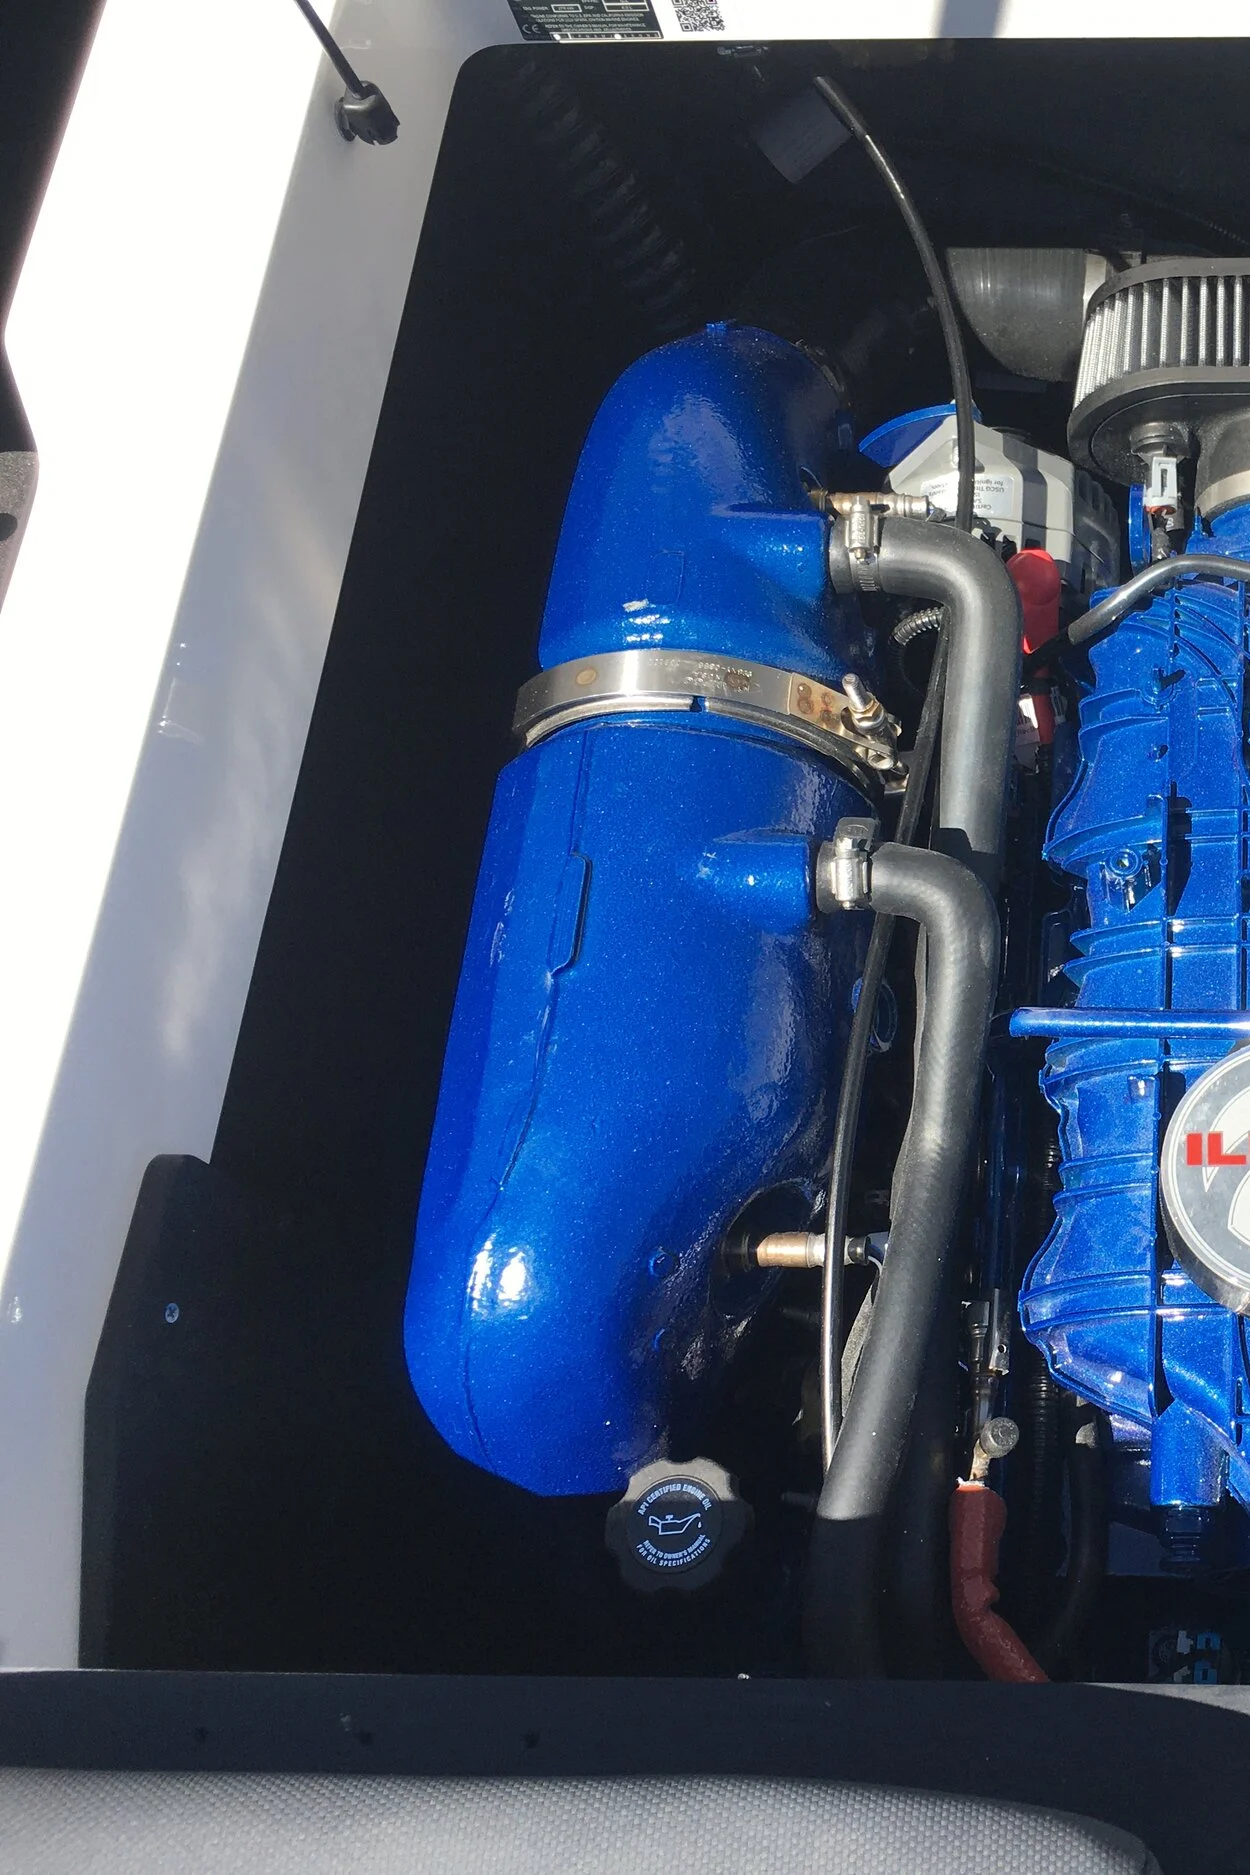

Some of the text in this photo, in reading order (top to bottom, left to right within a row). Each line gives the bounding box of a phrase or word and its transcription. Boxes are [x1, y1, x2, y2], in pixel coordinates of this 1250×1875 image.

[637, 1484, 713, 1515] API CERTIFIED ENGINE OIL
[636, 1538, 711, 1567] FOR OIL SPECIFICATIONS
[643, 1533, 706, 1559] REFER TO OWNER'S MANUAL
